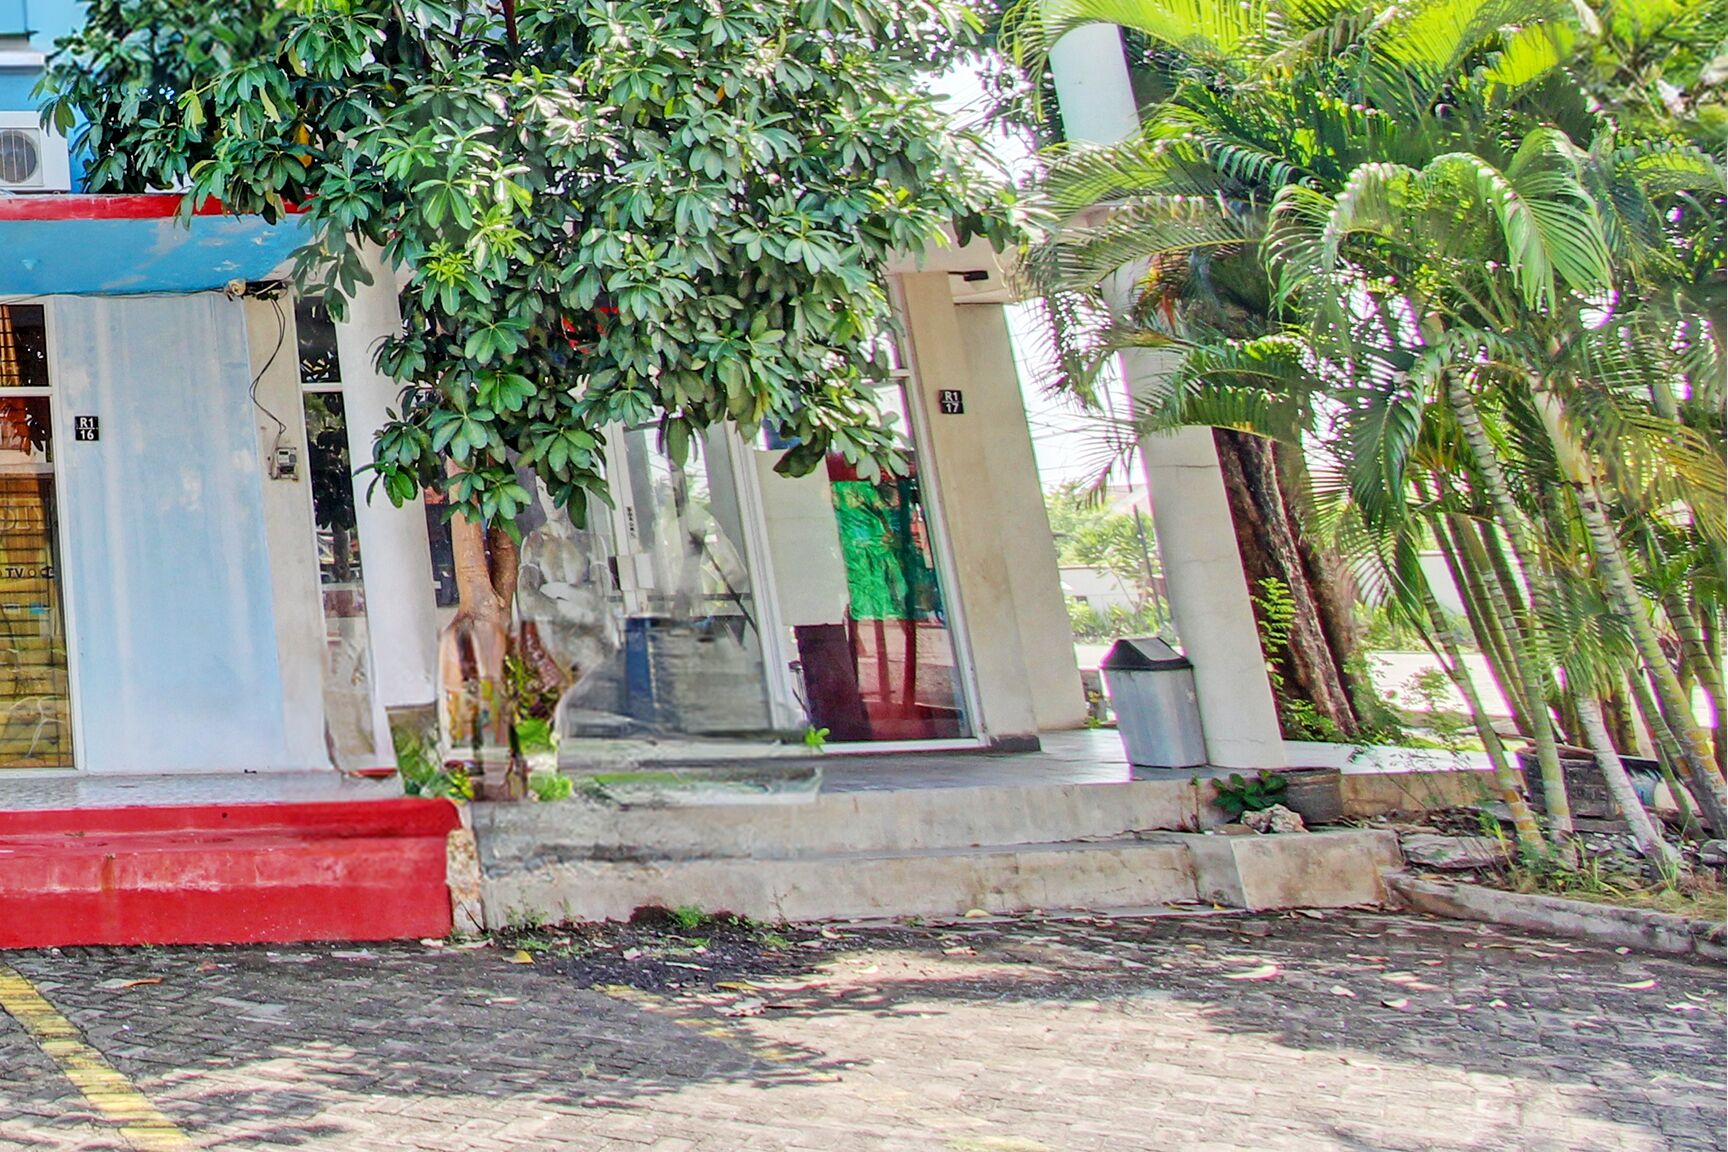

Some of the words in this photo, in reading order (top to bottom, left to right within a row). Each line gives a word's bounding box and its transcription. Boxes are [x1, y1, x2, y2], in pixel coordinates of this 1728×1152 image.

[944, 391, 958, 401] R1
[945, 402, 959, 413] 17
[80, 417, 93, 428] R1
[80, 429, 94, 440] 16
[5, 567, 24, 578] TV
